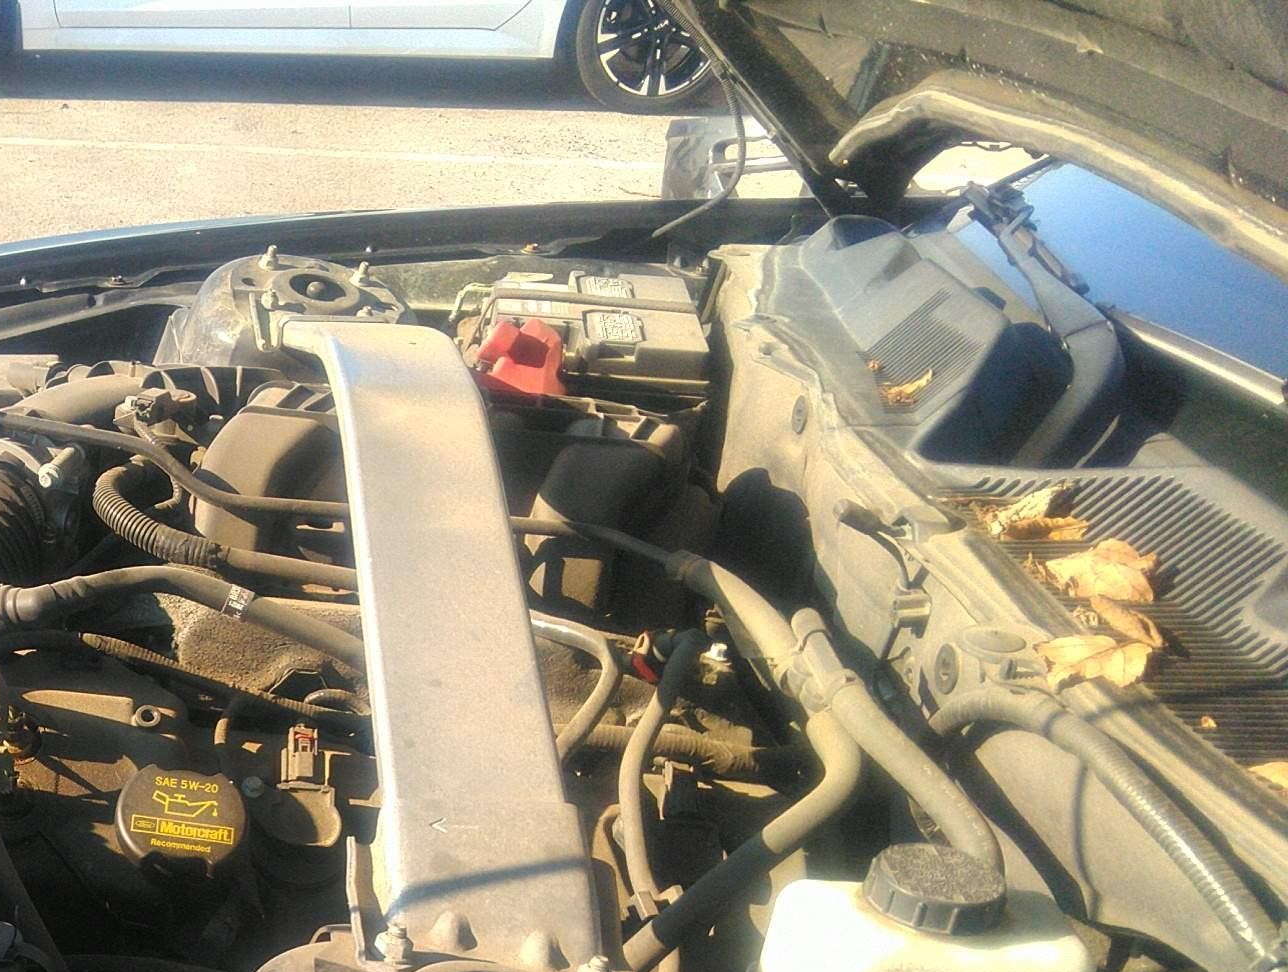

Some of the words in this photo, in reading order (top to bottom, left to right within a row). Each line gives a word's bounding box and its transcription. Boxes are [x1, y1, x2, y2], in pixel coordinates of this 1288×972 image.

[155, 776, 177, 788] SAE
[181, 780, 219, 793] 5W-20
[159, 820, 231, 842] Motorcraft
[151, 838, 211, 853] Recommended
